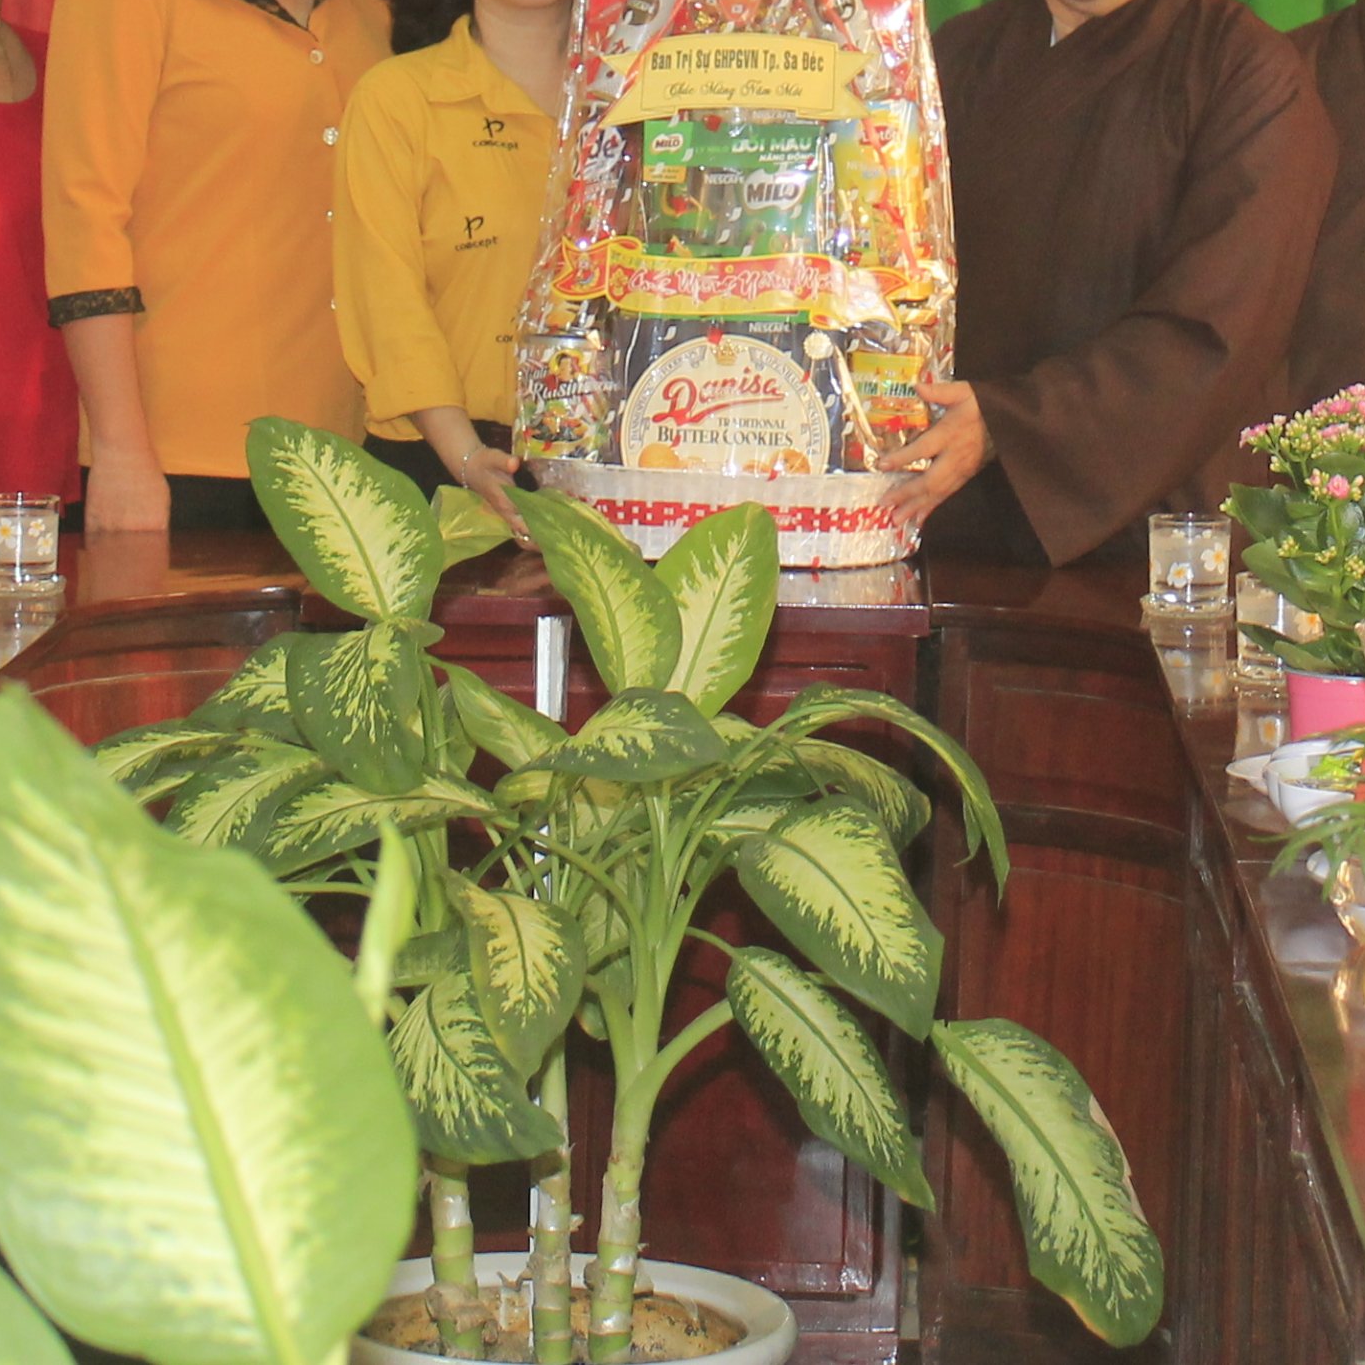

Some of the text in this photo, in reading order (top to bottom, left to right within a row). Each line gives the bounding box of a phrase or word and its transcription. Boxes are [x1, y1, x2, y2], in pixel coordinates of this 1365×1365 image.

[651, 51, 672, 71] Ban
[676, 49, 693, 74] Trị
[696, 49, 712, 74] Sự
[783, 49, 798, 71] Sa
[472, 139, 519, 151] concept
[655, 139, 681, 150] MILO
[747, 182, 801, 204] MILO
[455, 236, 498, 252] concept
[652, 366, 787, 426] Danisa
[717, 418, 786, 429] TRADITIONAL
[657, 425, 794, 447] BUTTER COOKIES
